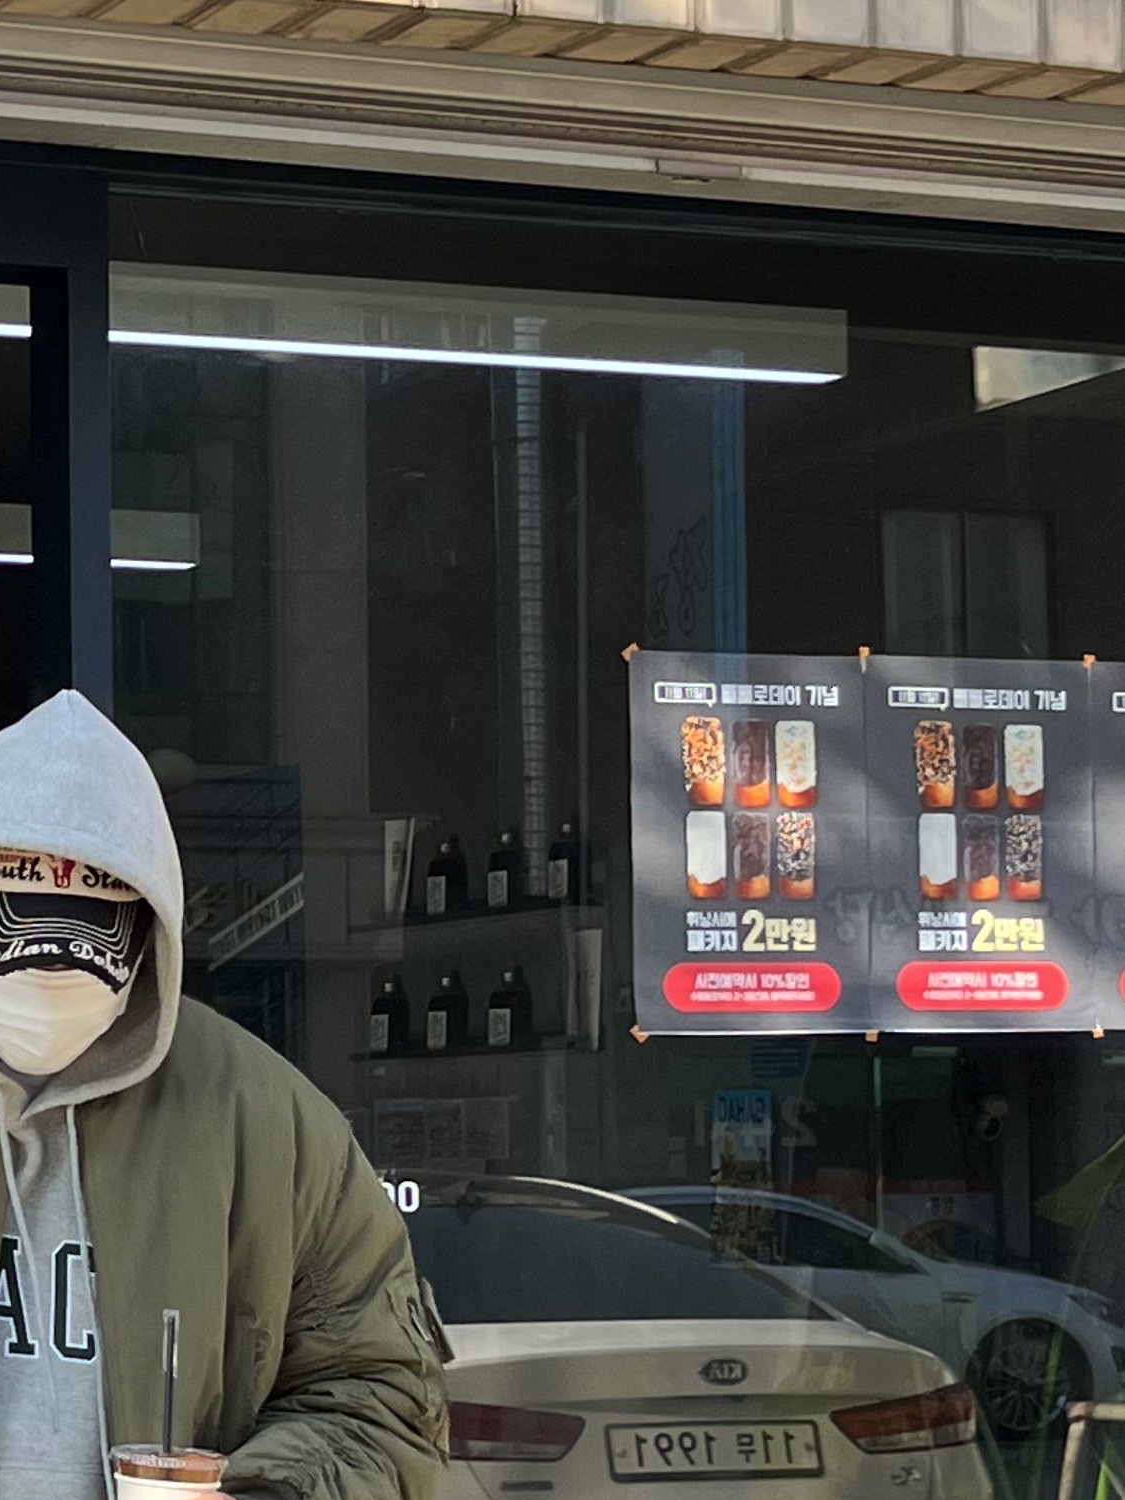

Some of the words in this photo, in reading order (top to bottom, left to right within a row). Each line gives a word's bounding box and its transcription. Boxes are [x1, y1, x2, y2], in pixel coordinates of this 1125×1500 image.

[804, 685, 840, 707] 기념
[1033, 690, 1067, 711] 기념
[741, 908, 817, 952] 2만원
[971, 908, 1045, 952] 2만원
